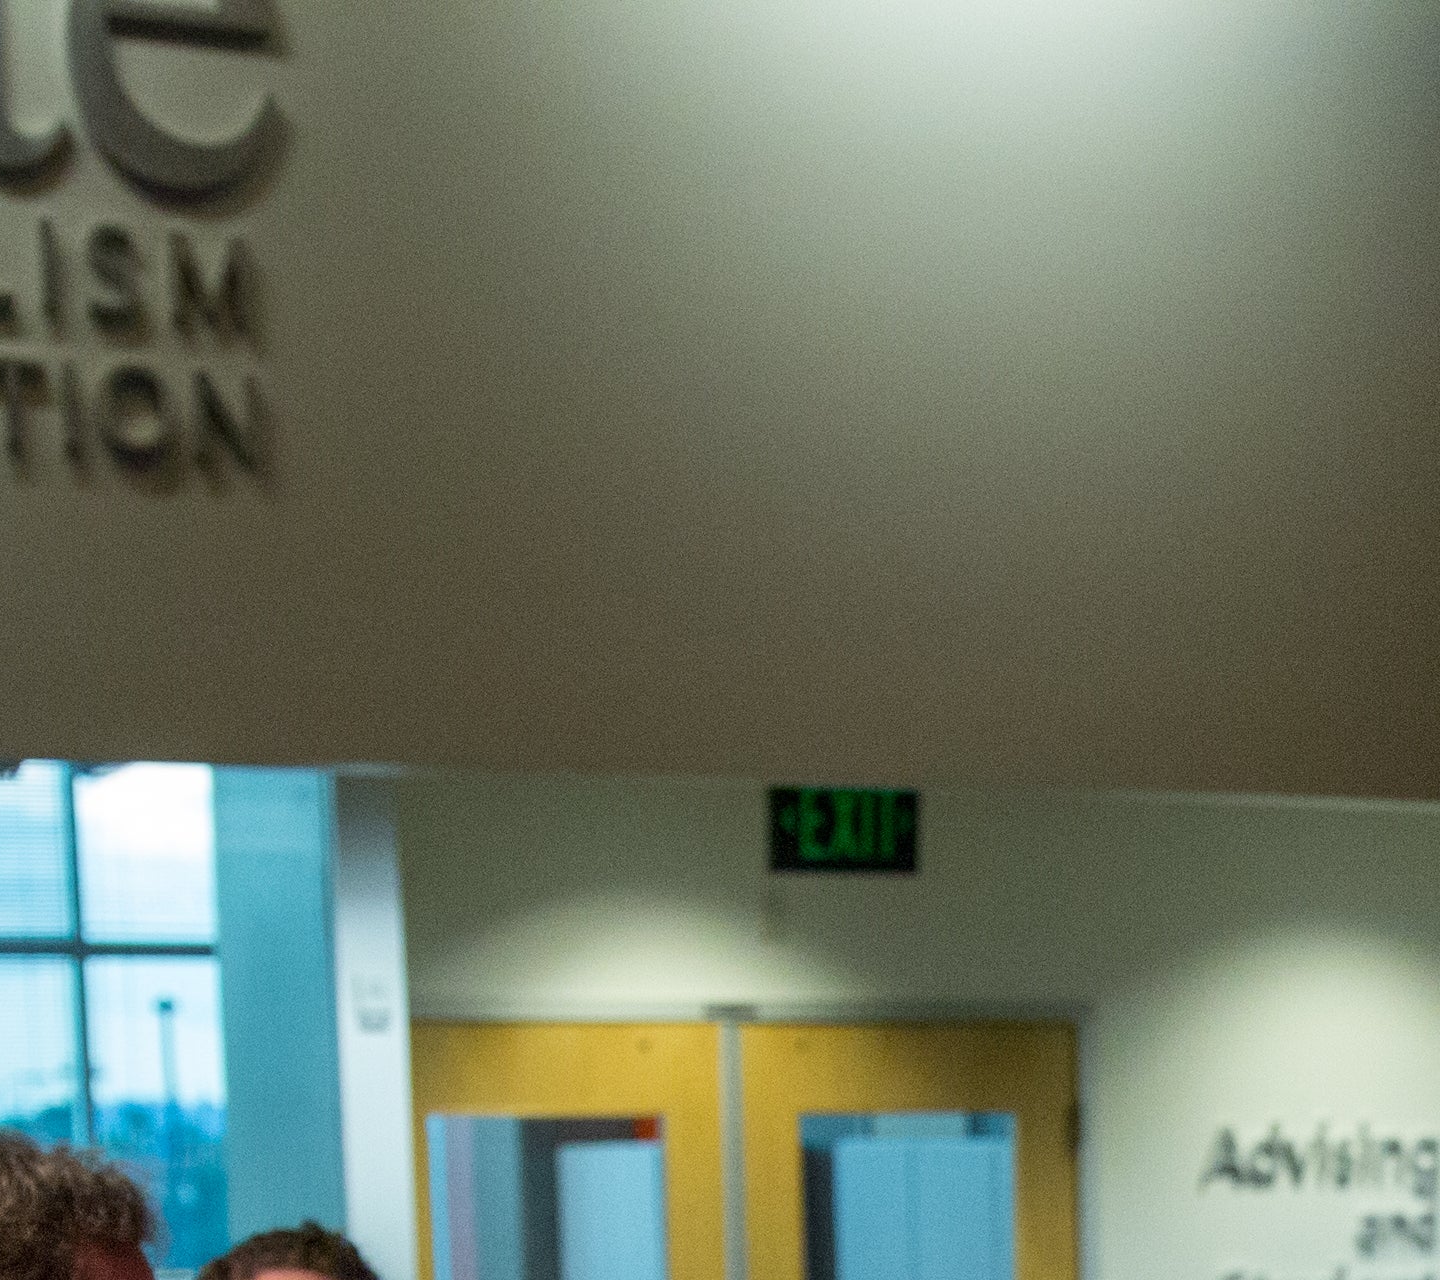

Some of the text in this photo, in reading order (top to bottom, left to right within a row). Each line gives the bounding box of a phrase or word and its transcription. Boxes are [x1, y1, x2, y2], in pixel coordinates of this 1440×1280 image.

[798, 786, 896, 860] EXIT
[1200, 1123, 1440, 1196] Advising
[1356, 1212, 1437, 1254] and
